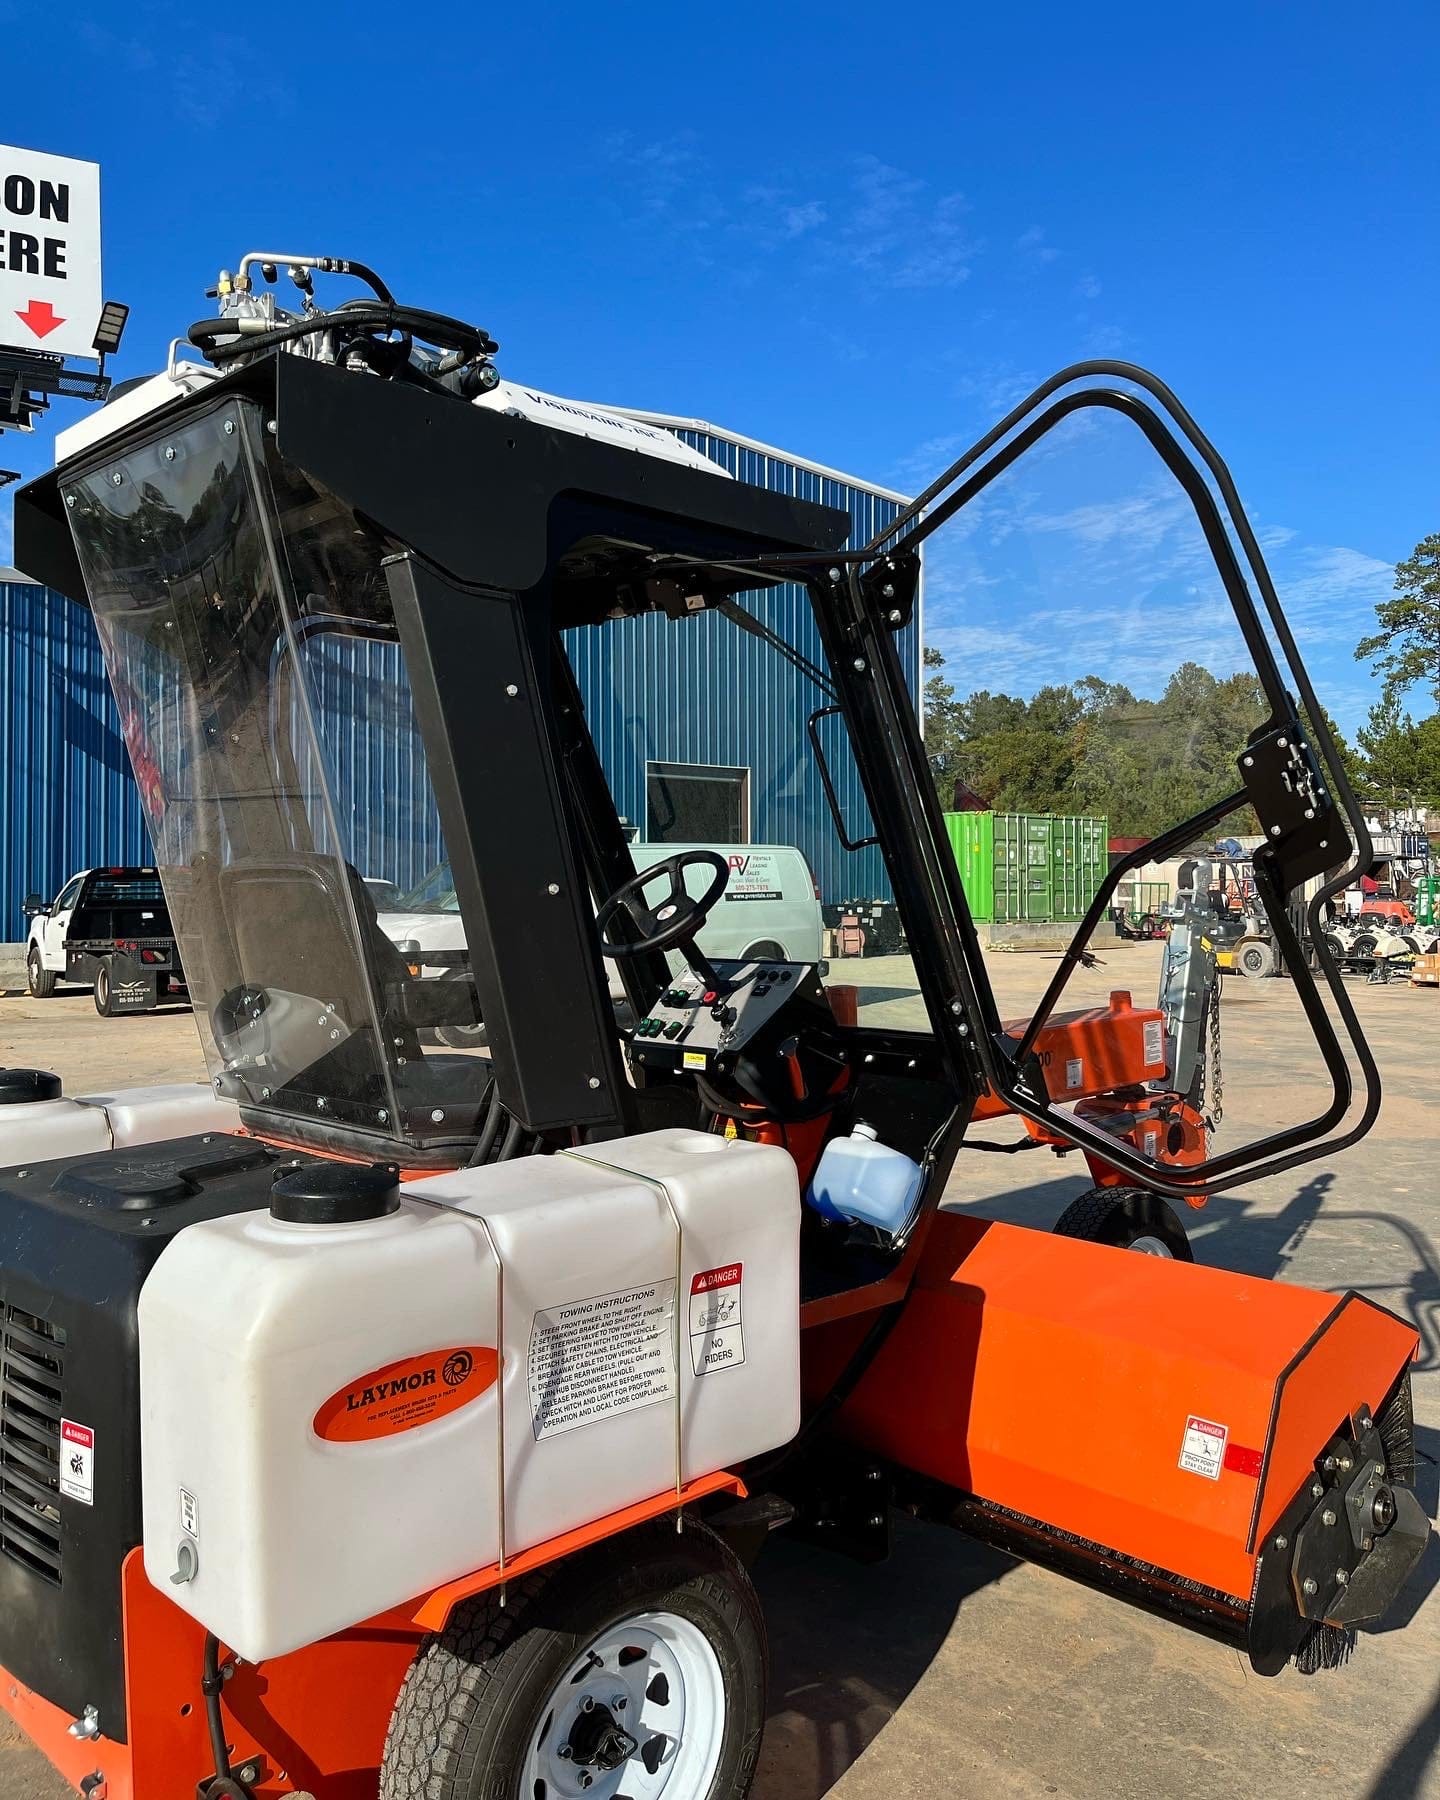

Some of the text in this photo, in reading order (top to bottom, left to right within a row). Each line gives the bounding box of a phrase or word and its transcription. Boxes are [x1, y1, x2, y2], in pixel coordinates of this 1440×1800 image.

[0, 174, 69, 223] ON
[0, 229, 67, 279] RE
[708, 1268, 738, 1286] DANGER
[560, 1289, 655, 1319] TOWING INSTRUCTIONS
[538, 1336, 551, 1345] SET
[552, 1328, 578, 1341] PARKING
[580, 1324, 599, 1333] BRAKE
[600, 1320, 614, 1328] AND
[614, 1316, 630, 1325] SHUT
[630, 1312, 641, 1321] OFF
[538, 1345, 550, 1354] SET
[550, 1336, 580, 1351] STEERING
[580, 1332, 599, 1341] VALVE
[608, 1326, 620, 1334] TOW
[540, 1326, 560, 1337] STEER
[560, 1320, 580, 1331] FRONT
[582, 1315, 602, 1325] WHEEL
[537, 1348, 568, 1363] SECURELY
[570, 1342, 593, 1353] FASTEN
[593, 1337, 611, 1347] HITCH
[620, 1331, 632, 1339] TOW
[537, 1360, 560, 1372] ATTACH
[560, 1353, 584, 1365] SAFETY
[610, 1336, 644, 1351] ELECTRICAL
[646, 1332, 659, 1341] AND
[704, 1349, 733, 1365] RIDERS
[712, 1338, 723, 1349] NO
[538, 1365, 575, 1381] BREAKAWAY
[576, 1358, 596, 1370] CABLE
[605, 1352, 618, 1361] TOW
[538, 1374, 573, 1391] DISENGAGE
[574, 1370, 591, 1379] REAR
[618, 1358, 635, 1368] (PULL
[636, 1353, 647, 1362] OUT
[648, 1350, 661, 1359] AND
[346, 1368, 436, 1412] LAYMOR
[538, 1366, 635, 1400] TURN HUB DISCONNECT HANDLE)
[542, 1394, 570, 1409] RELEASE
[570, 1386, 597, 1399] PARKING
[598, 1380, 619, 1392] BRAKE
[619, 1372, 643, 1386] BEFORE
[542, 1406, 564, 1420] CHECK
[564, 1401, 582, 1412] HITCH
[583, 1396, 596, 1406] AND
[597, 1391, 614, 1402] LIGHT
[615, 1387, 628, 1396] FOR
[628, 1380, 652, 1392] PROPER
[543, 1412, 578, 1429] OPERATION
[579, 1408, 592, 1417] AND
[592, 1402, 613, 1413] LOCAL
[614, 1396, 630, 1407] CODE
[70, 1429, 90, 1442] DANGER
[1198, 1422, 1223, 1436] DANGER
[1184, 1460, 1214, 1474] STAY CLEAR
